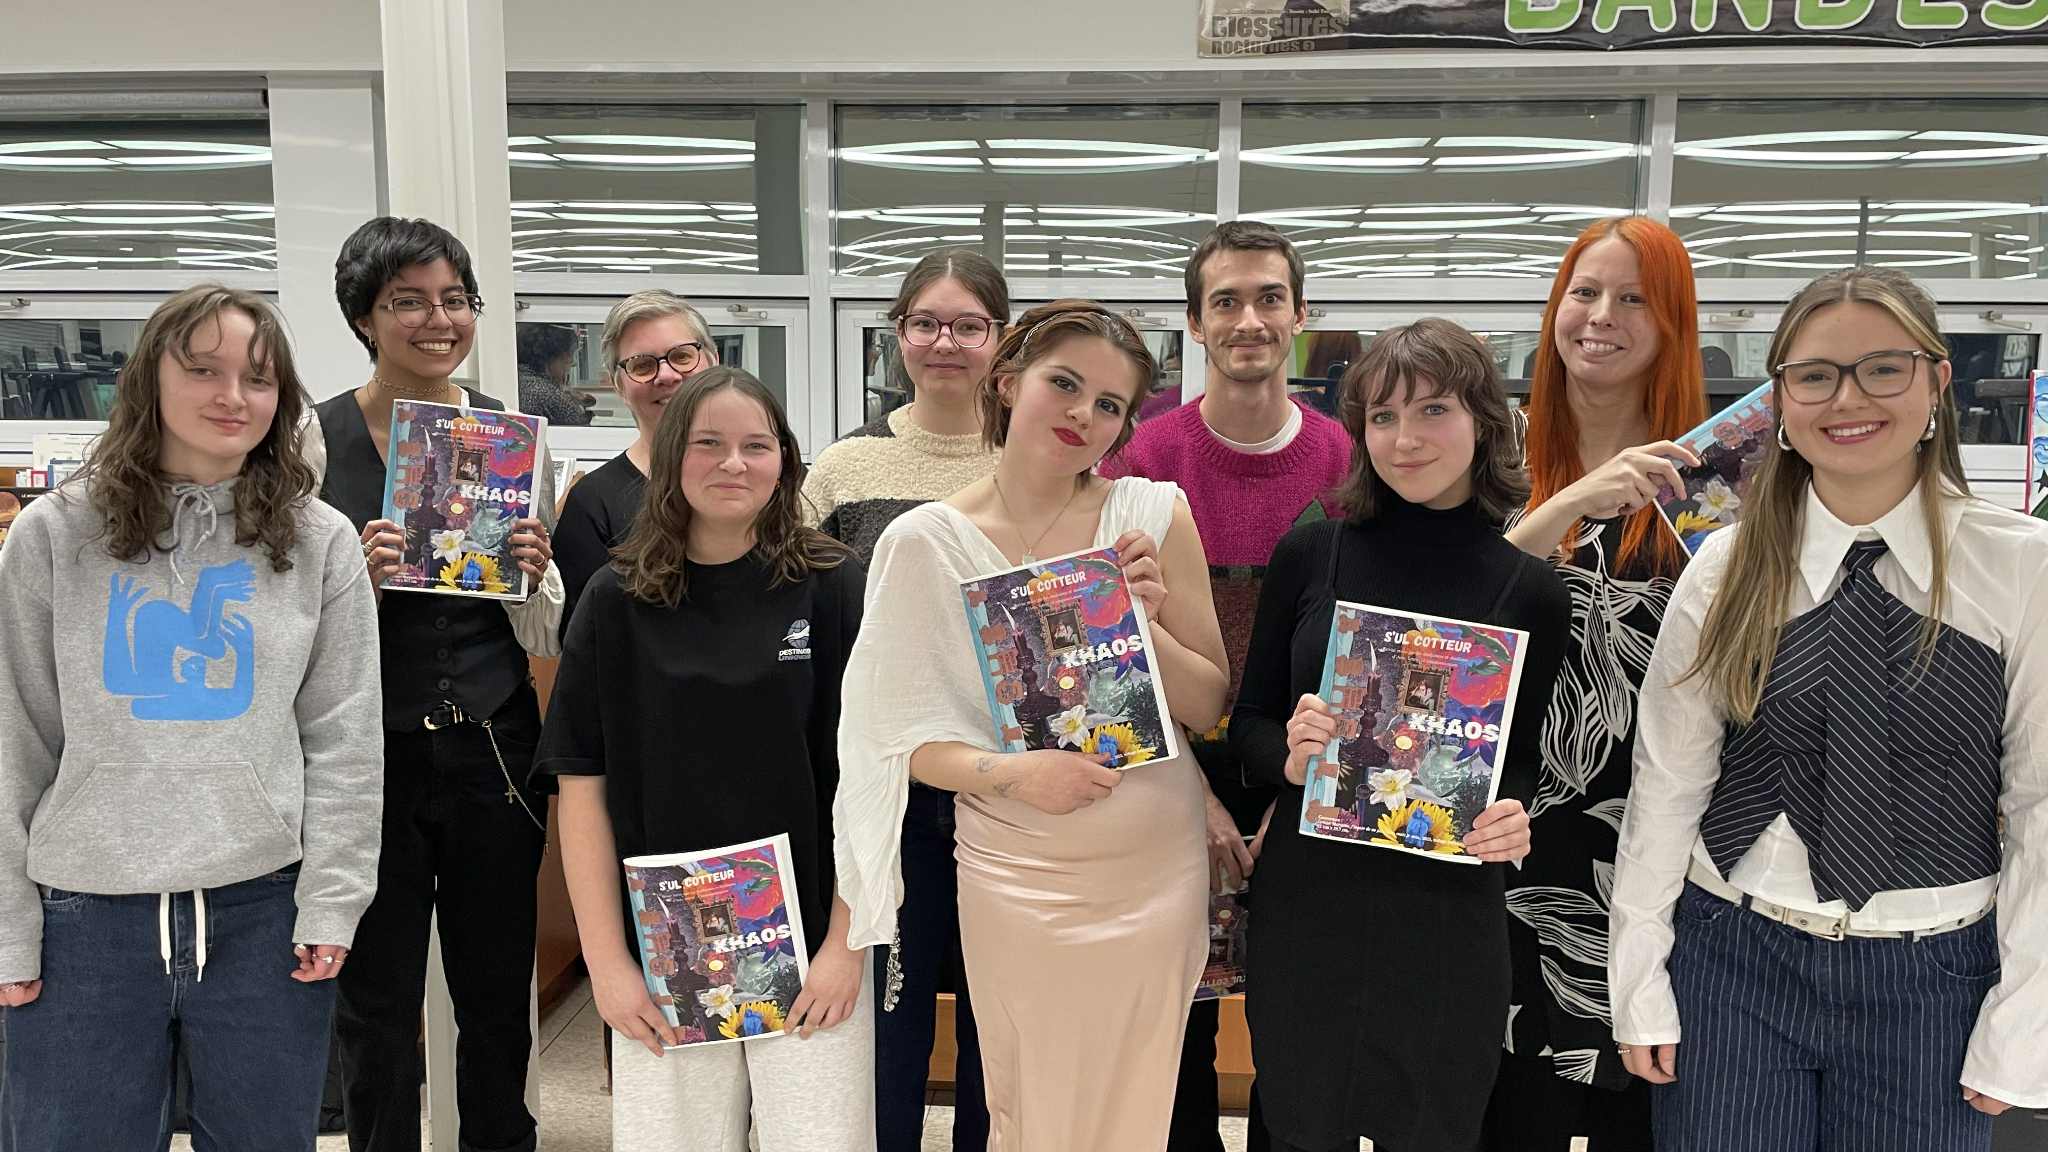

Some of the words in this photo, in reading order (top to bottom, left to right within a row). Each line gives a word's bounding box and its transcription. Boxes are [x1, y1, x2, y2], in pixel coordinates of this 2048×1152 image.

[435, 418, 457, 430] S'UL
[460, 421, 505, 436] COTTEUR
[460, 484, 531, 505] KHAOS
[1010, 585, 1034, 599] S'UL
[1037, 570, 1087, 592] COTTEUR
[1062, 634, 1143, 668] KHAOS
[1383, 630, 1410, 645] S'UL
[1413, 636, 1472, 653] COTTEUR
[1408, 712, 1500, 742] KHAOS
[658, 879, 682, 891] S'UL
[684, 869, 735, 887] COTTEUR
[714, 924, 791, 953] KHAOS
